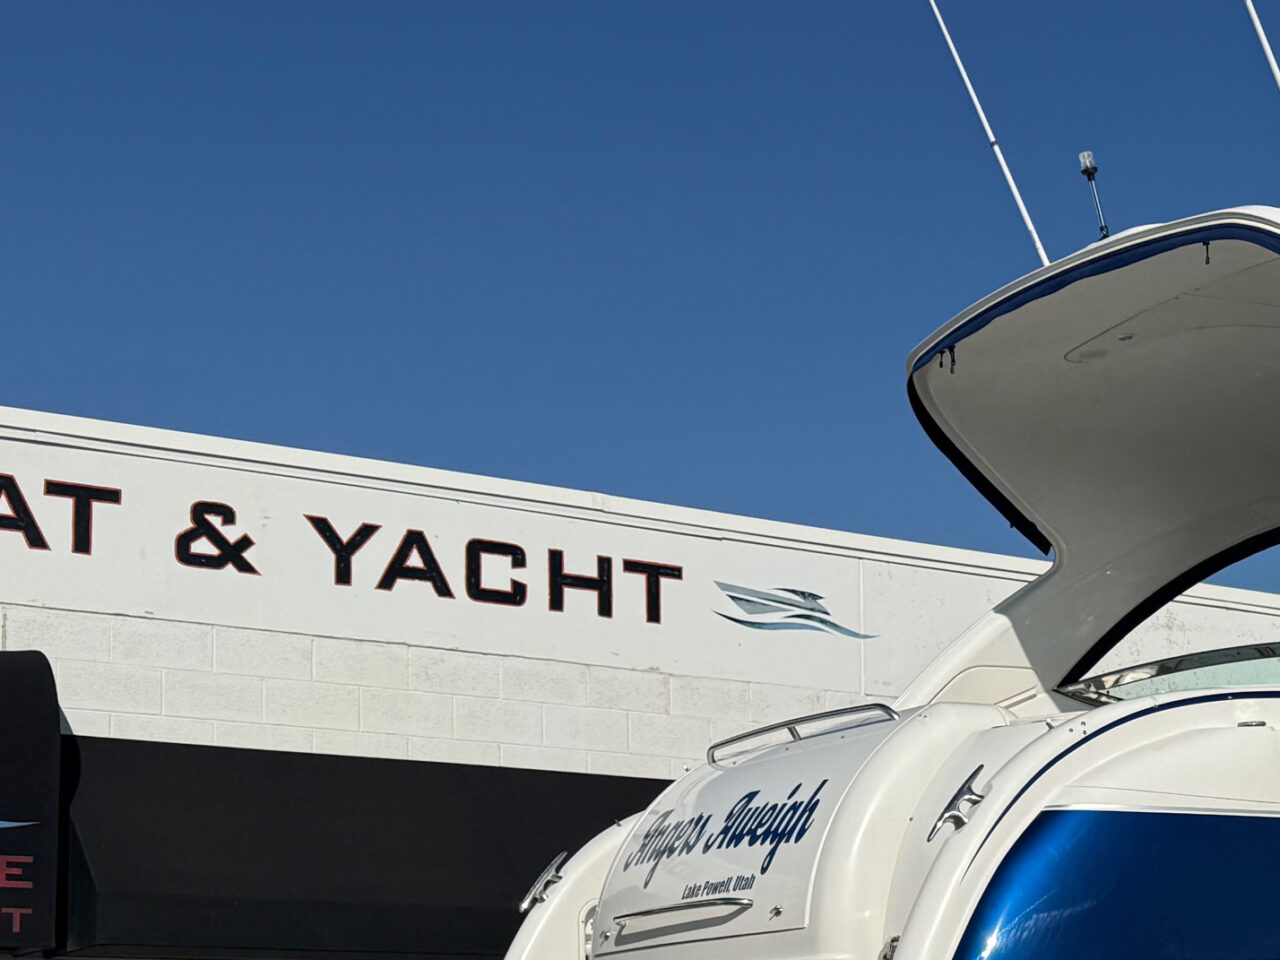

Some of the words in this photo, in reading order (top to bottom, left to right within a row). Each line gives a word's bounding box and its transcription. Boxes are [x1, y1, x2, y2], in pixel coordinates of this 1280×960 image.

[174, 500, 261, 576] &
[303, 513, 684, 624] YACHT
[702, 778, 829, 876] Aweigh
[681, 883, 702, 901] Lake
[701, 877, 731, 897] Powell,
[732, 873, 757, 893] Utah
[1, 907, 33, 933] T
